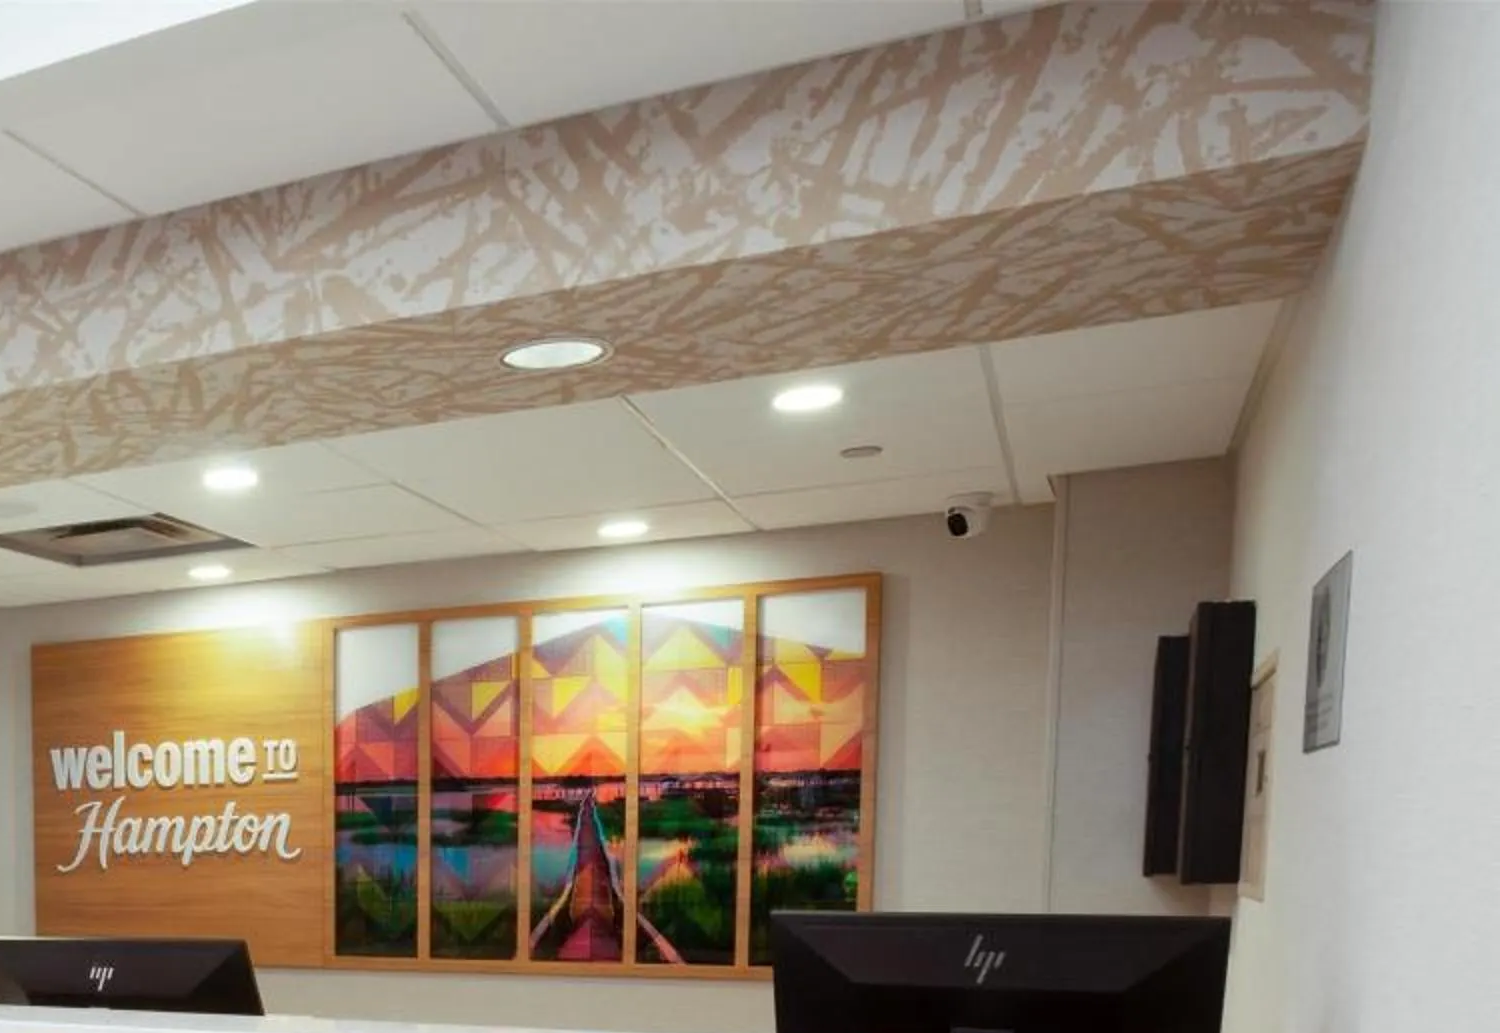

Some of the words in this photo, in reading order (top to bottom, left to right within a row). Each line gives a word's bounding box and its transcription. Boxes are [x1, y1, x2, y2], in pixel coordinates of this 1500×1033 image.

[51, 730, 257, 790] welcome
[262, 738, 298, 772] TO
[55, 796, 301, 873] Hampton
[964, 933, 1005, 984] hp
